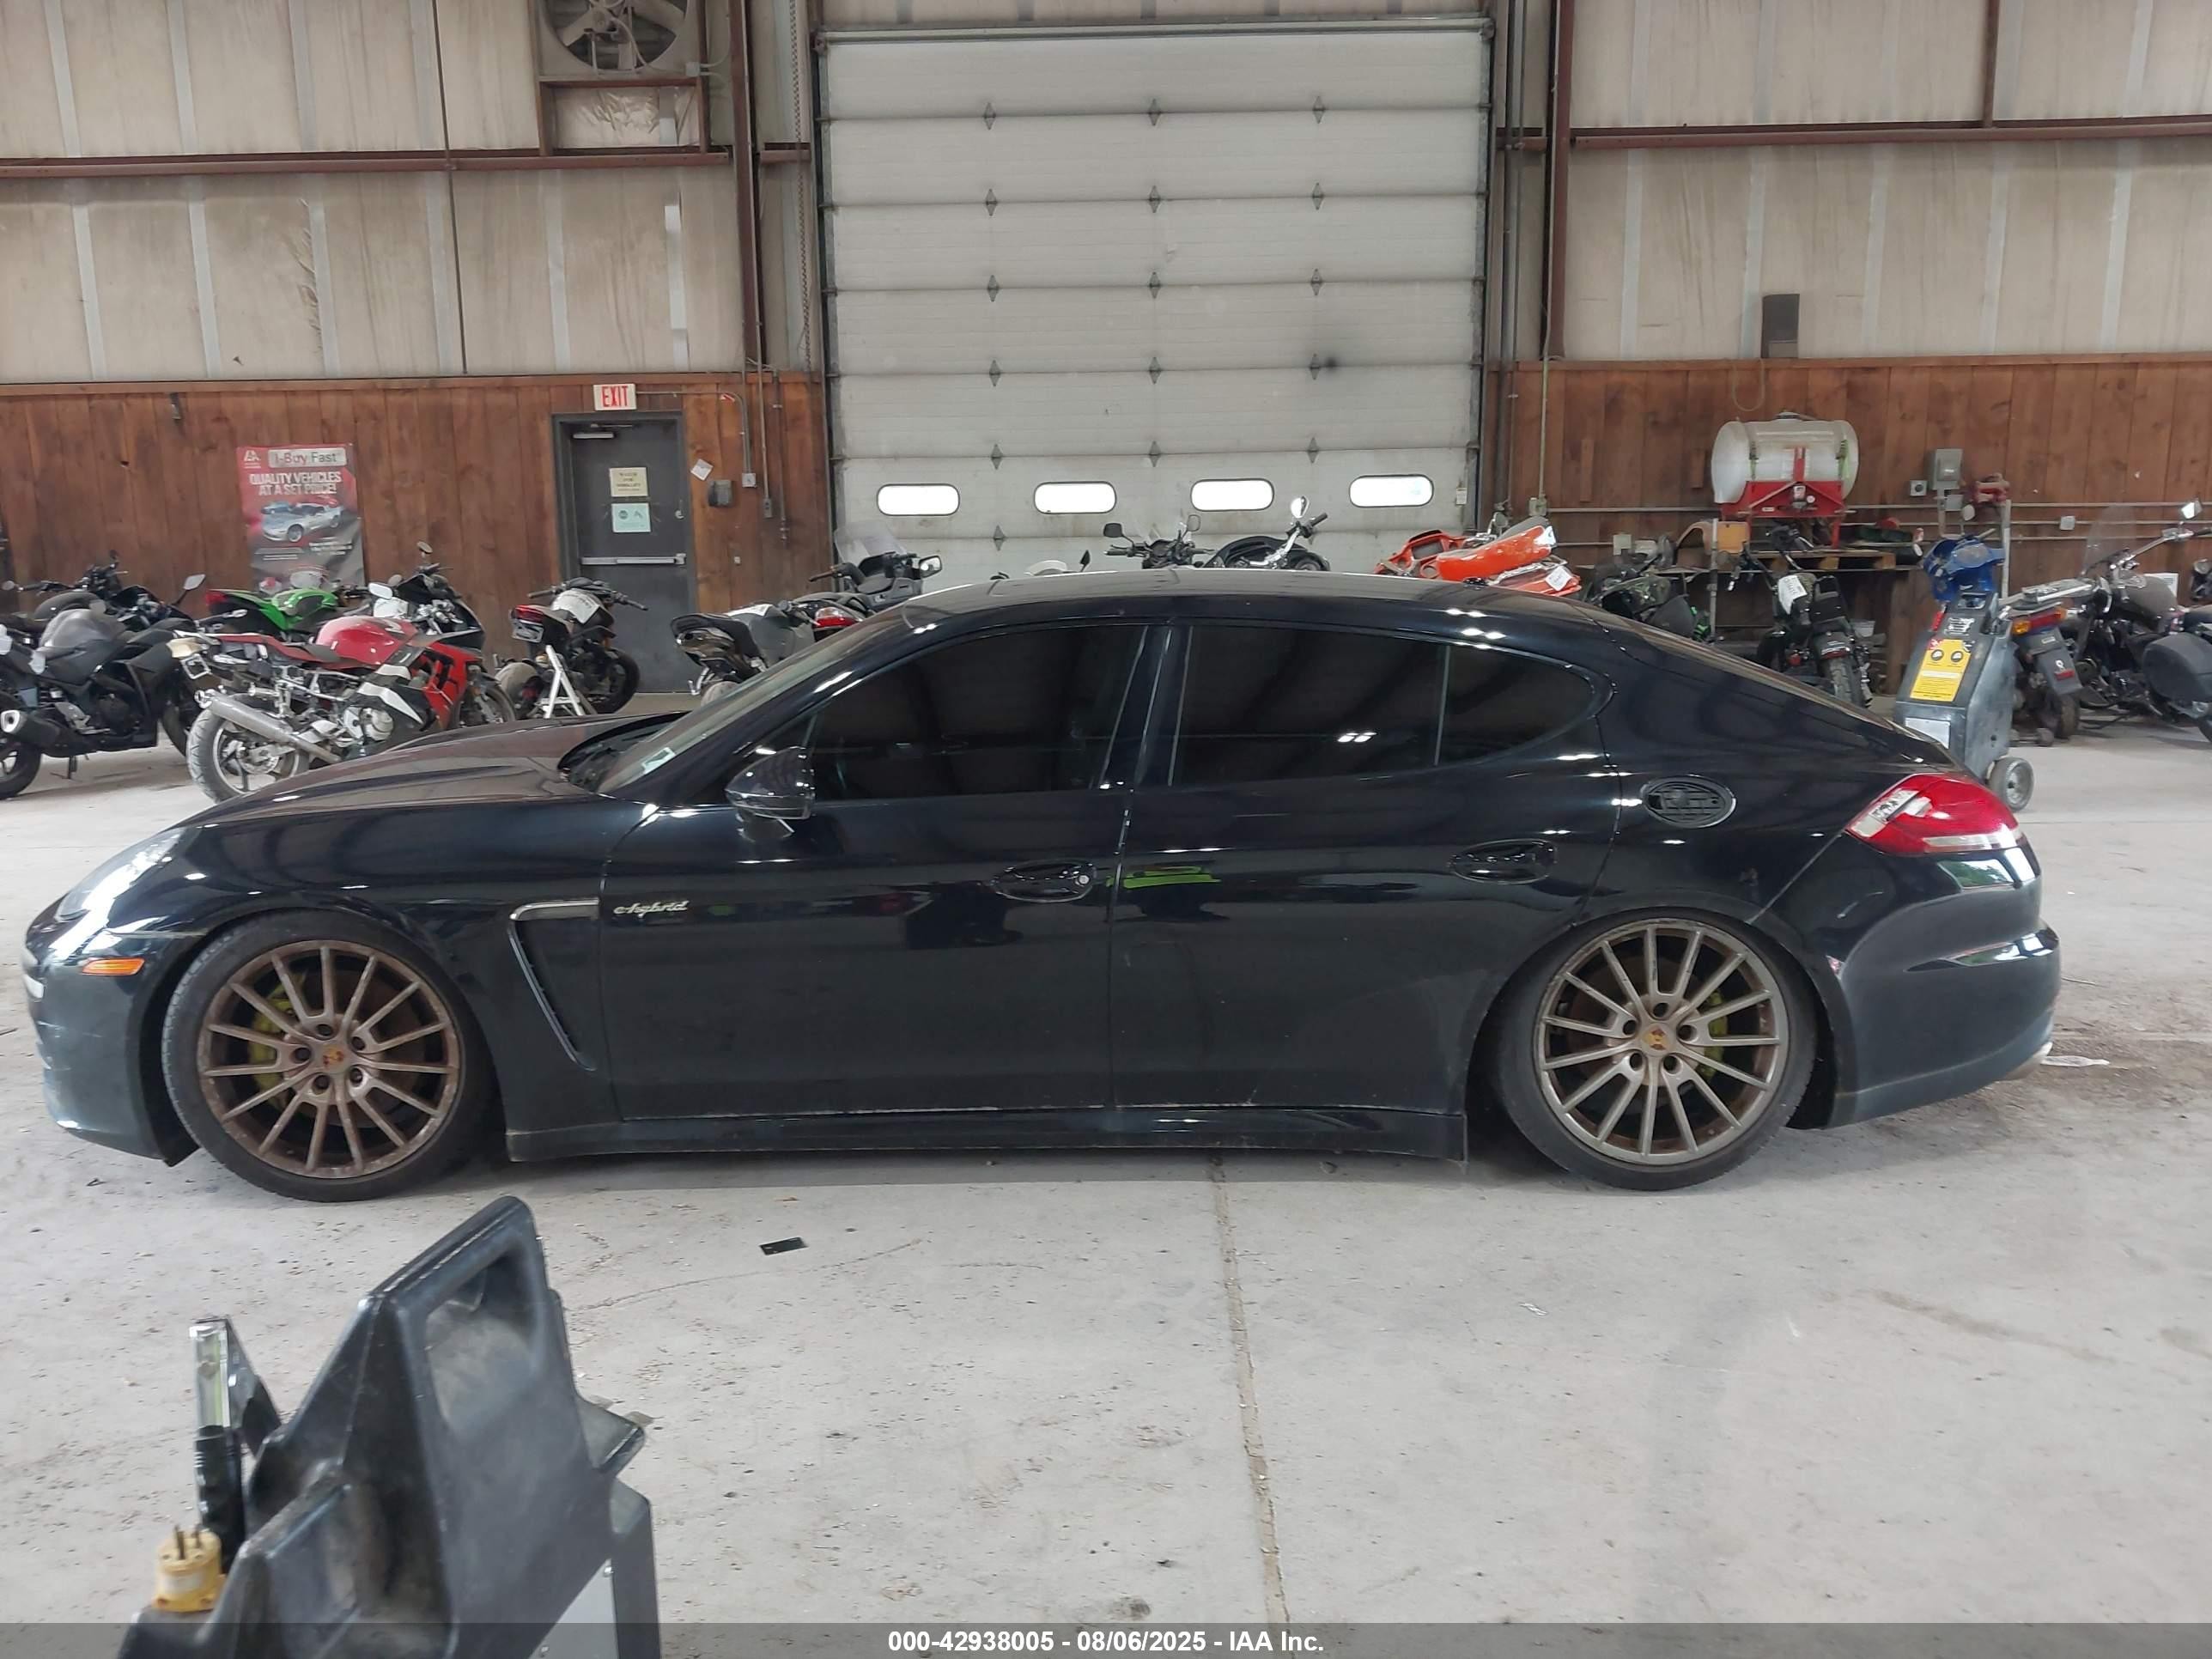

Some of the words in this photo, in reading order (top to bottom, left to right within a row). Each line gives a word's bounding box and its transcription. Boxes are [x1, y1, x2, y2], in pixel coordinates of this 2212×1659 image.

[602, 386, 629, 408] EXIT
[274, 452, 307, 465] I-Buy
[311, 451, 337, 463] Fast
[249, 472, 293, 485] QUALITY
[293, 471, 343, 483] VEHICLES
[258, 484, 273, 496] AT
[274, 484, 283, 495] A
[283, 483, 301, 495] SET
